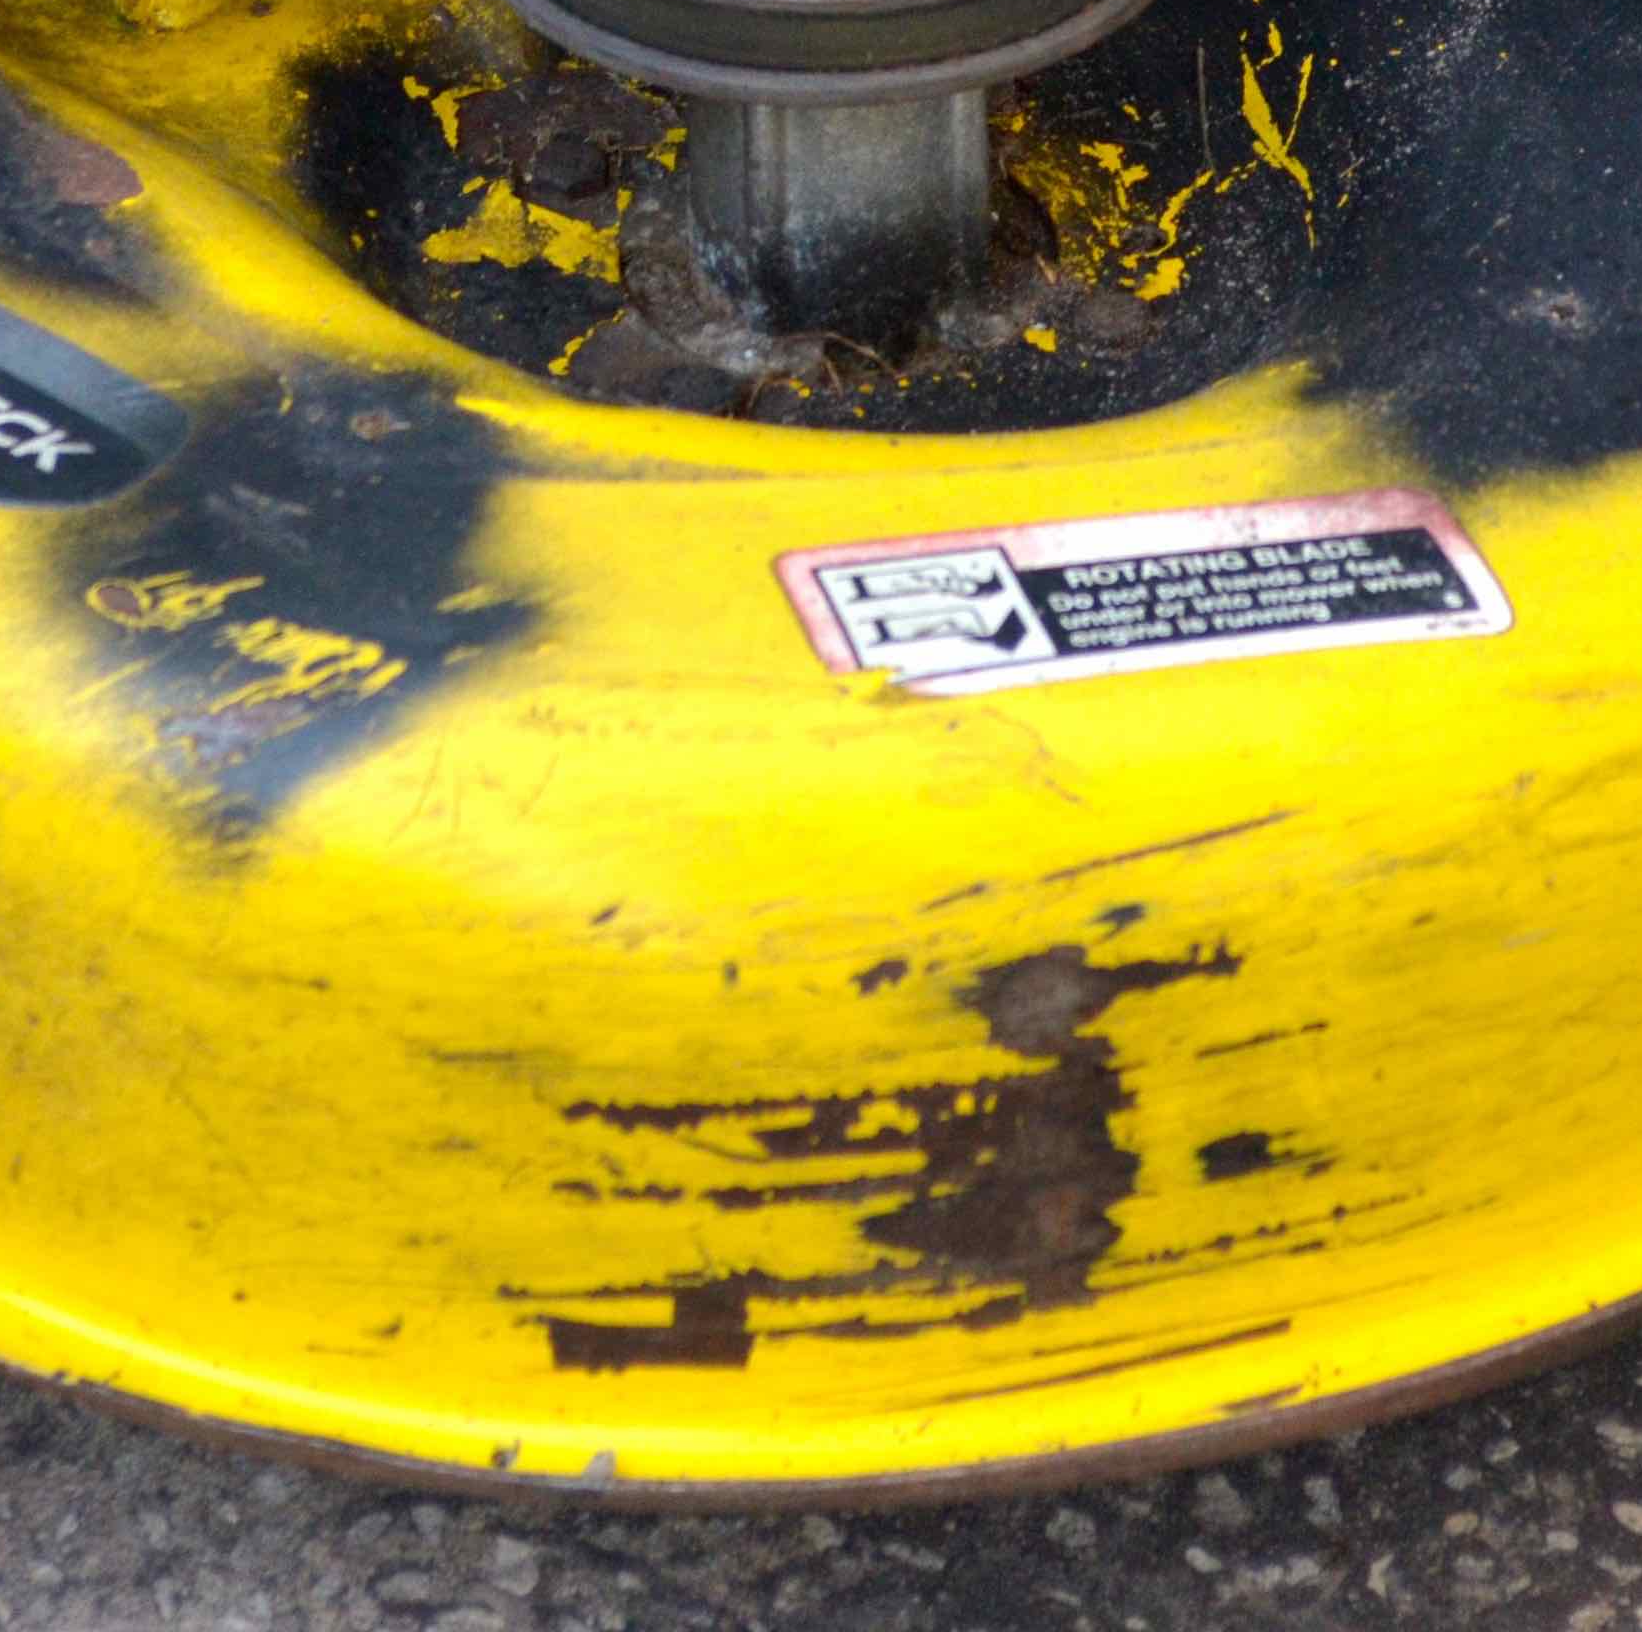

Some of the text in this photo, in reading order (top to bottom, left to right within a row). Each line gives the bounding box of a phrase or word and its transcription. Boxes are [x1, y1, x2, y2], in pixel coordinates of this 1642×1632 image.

[1047, 591, 1094, 613] Do
[1099, 584, 1149, 606] not
[1155, 578, 1207, 601] put
[1209, 568, 1304, 593] hands
[1308, 564, 1339, 582] or
[1063, 538, 1373, 589] ROTATING BLADE
[1059, 572, 1443, 630] under or into mower when
[1069, 602, 1331, 648] engine is running
